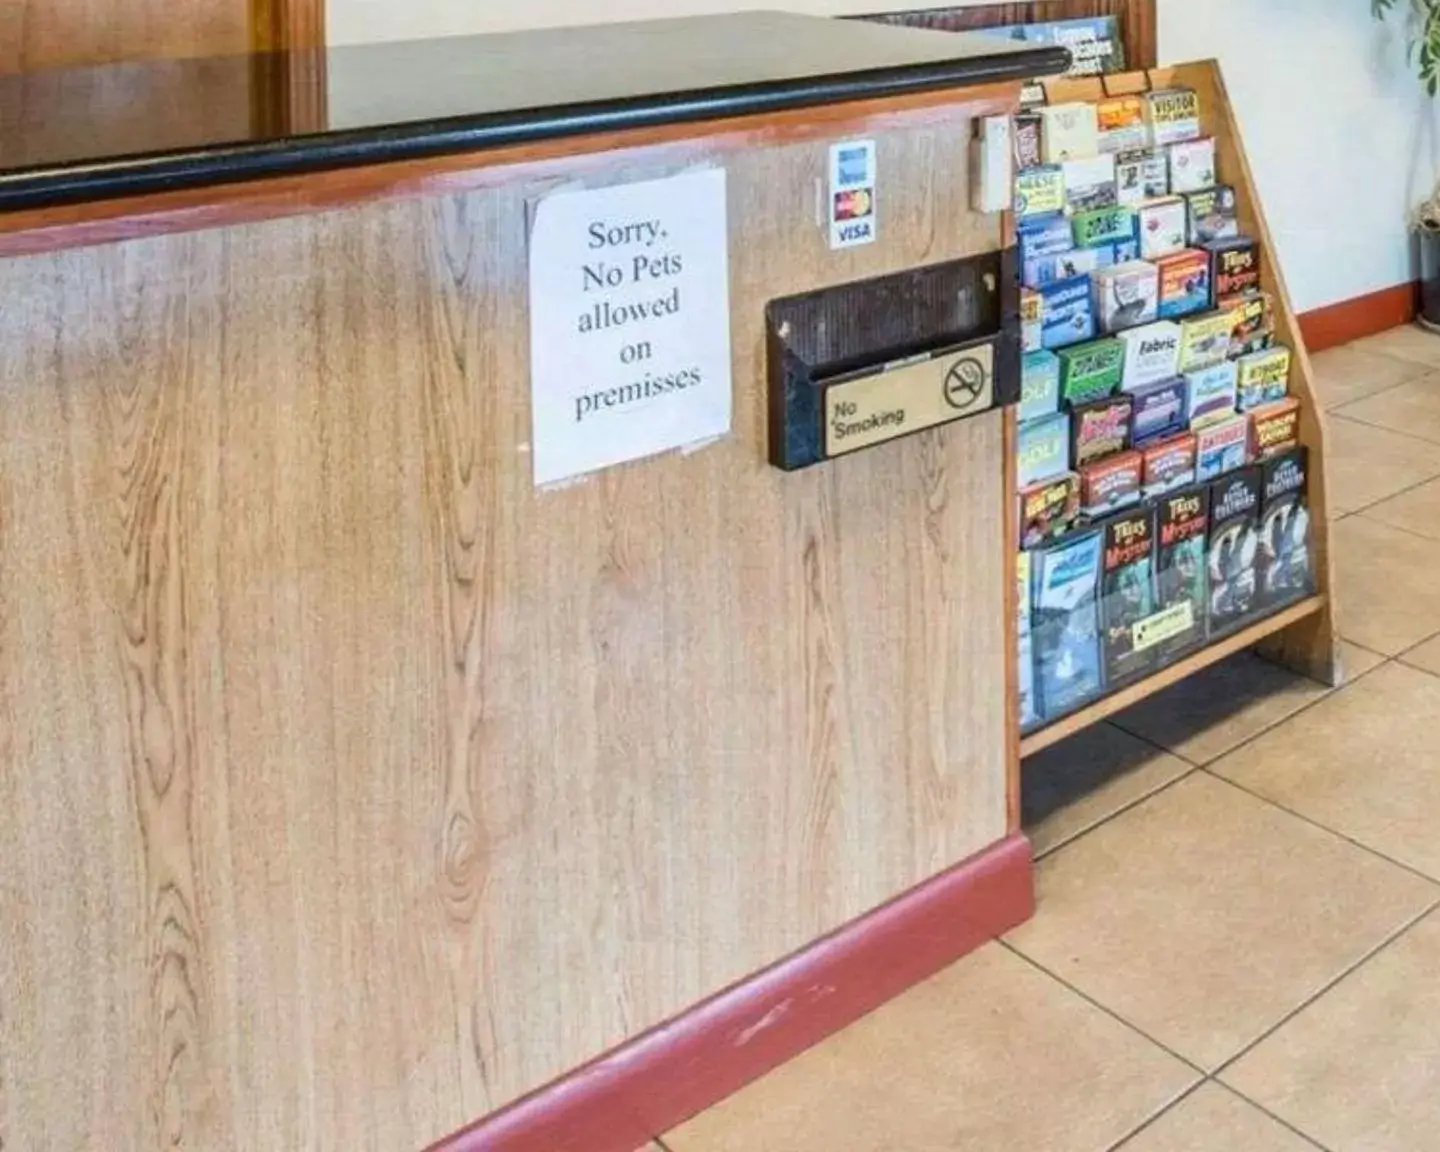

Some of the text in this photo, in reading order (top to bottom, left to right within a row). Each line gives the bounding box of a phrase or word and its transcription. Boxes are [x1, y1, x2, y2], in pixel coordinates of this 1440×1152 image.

[839, 224, 871, 241] VISA
[581, 253, 684, 291] No Pets
[578, 287, 680, 334] allowed
[620, 341, 652, 365] on
[574, 366, 702, 423] premisses
[833, 401, 858, 418] No
[834, 408, 906, 440] Smoking
